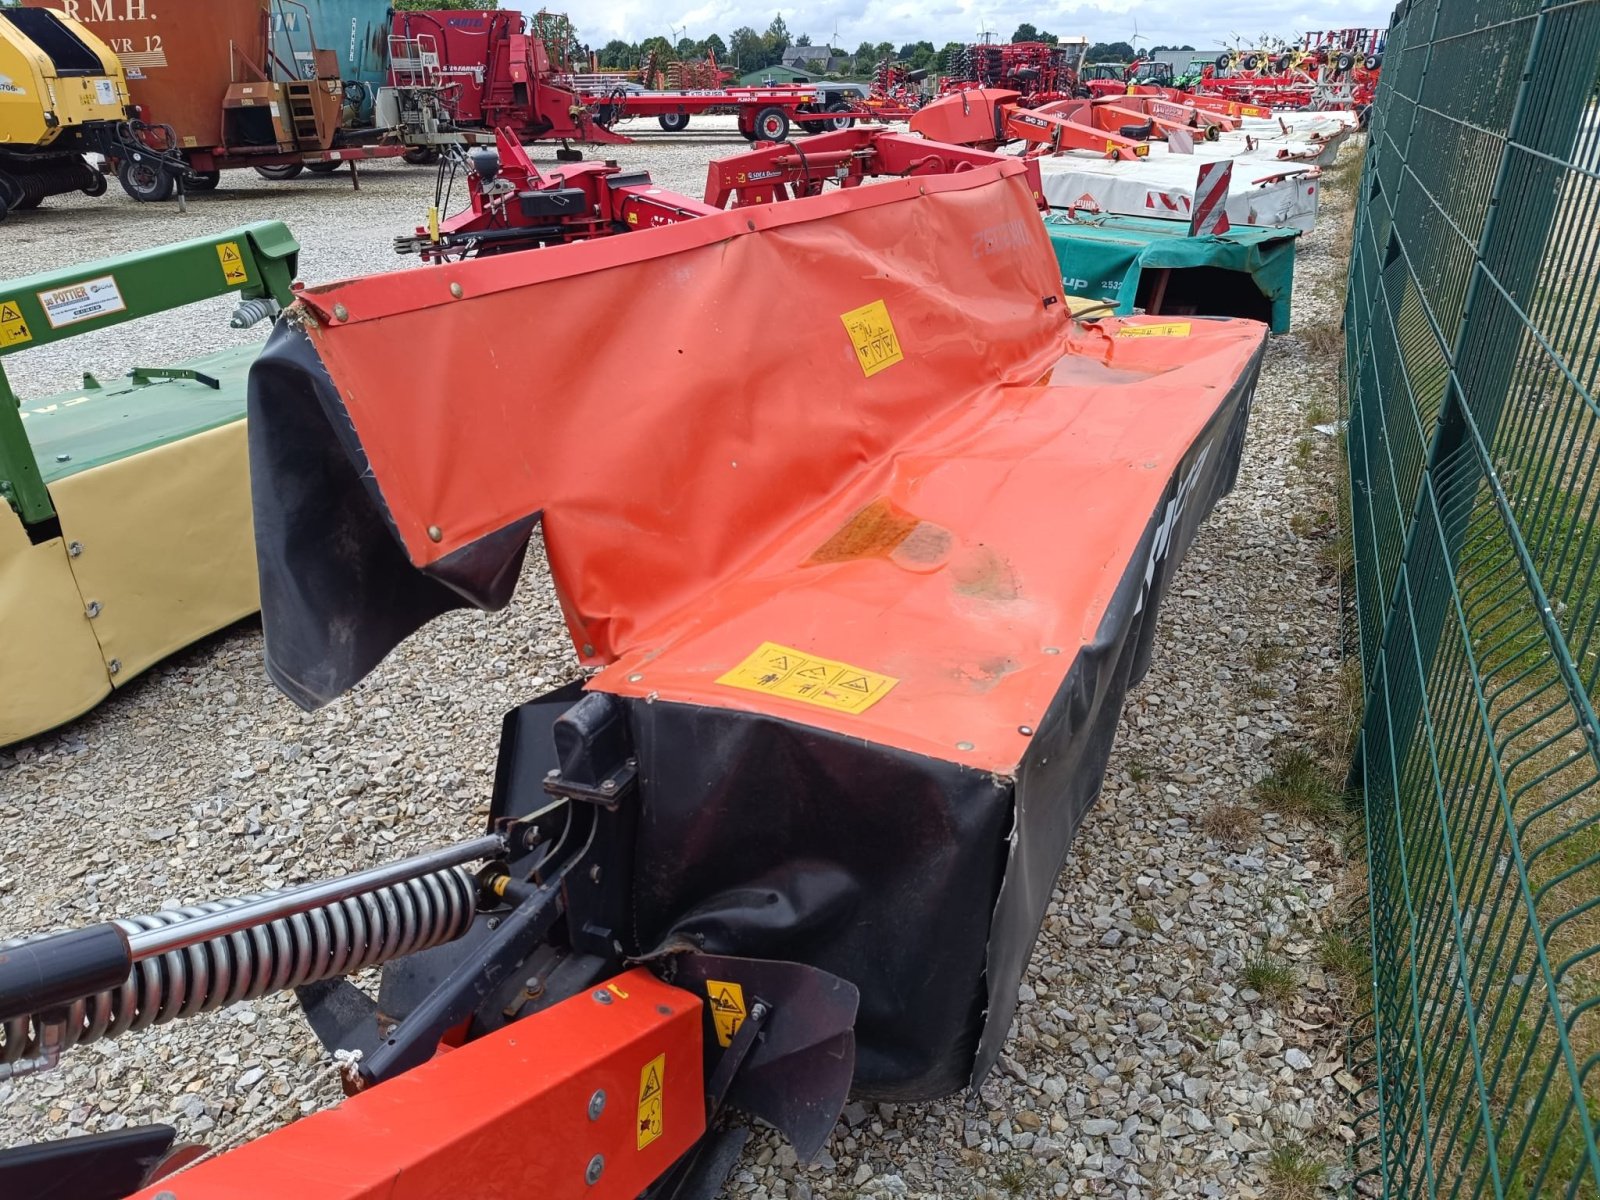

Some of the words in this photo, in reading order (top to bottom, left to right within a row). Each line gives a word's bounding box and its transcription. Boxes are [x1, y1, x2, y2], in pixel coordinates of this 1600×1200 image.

[110, 38, 134, 52] VR
[144, 35, 163, 52] 12
[52, 286, 88, 304] POTTIER
